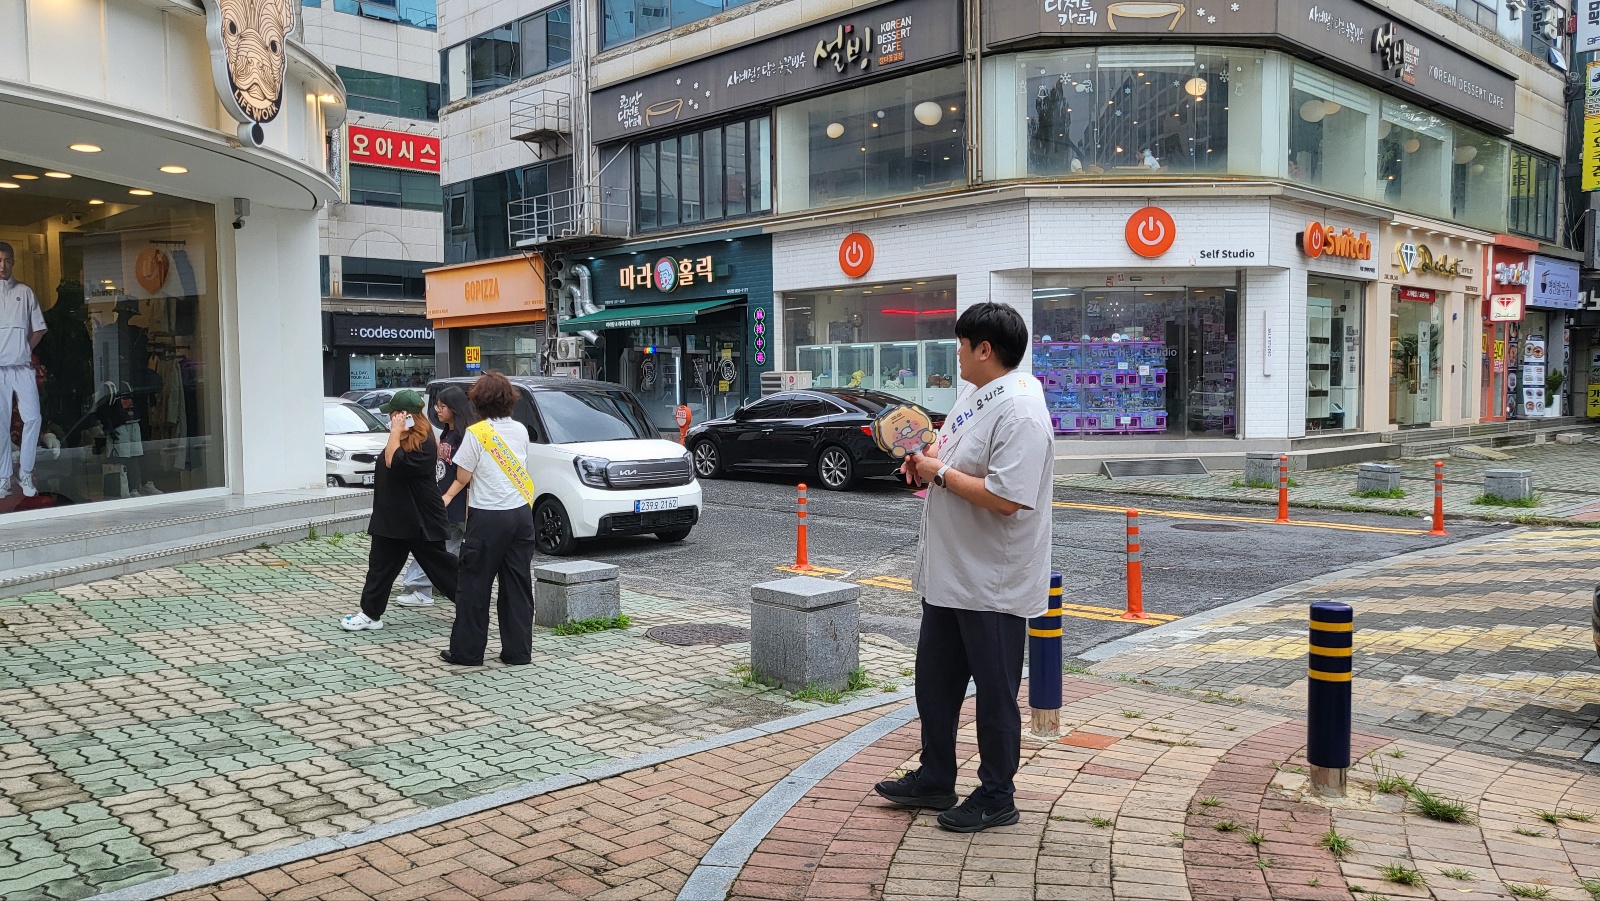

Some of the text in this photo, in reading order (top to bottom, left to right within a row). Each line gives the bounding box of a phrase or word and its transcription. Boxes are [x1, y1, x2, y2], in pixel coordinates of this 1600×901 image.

[880, 15, 912, 33] KOREAN
[1057, 8, 1097, 26] 카페
[877, 27, 911, 45] DESSERT
[813, 23, 872, 73] 설빙
[881, 41, 902, 55] CAFE
[1375, 22, 1406, 77] 설빙
[1428, 64, 1457, 88] KOREAN
[1458, 78, 1487, 101] DESSERT
[1488, 92, 1505, 109] CAFE
[617, 105, 640, 122] 디저트
[623, 114, 643, 130] 카페
[352, 134, 437, 165] 오아시스
[1324, 225, 1372, 261] Switch
[1200, 249, 1255, 259] Self Studio
[619, 254, 713, 290] 마라 홀릭
[464, 277, 500, 303] GOPIZZA
[1087, 303, 1100, 313] 24
[360, 326, 397, 338] codes
[466, 348, 480, 362] 임대
[976, 385, 1005, 411] 친구야
[951, 408, 974, 434] 고마워
[660, 499, 677, 509] 2162
